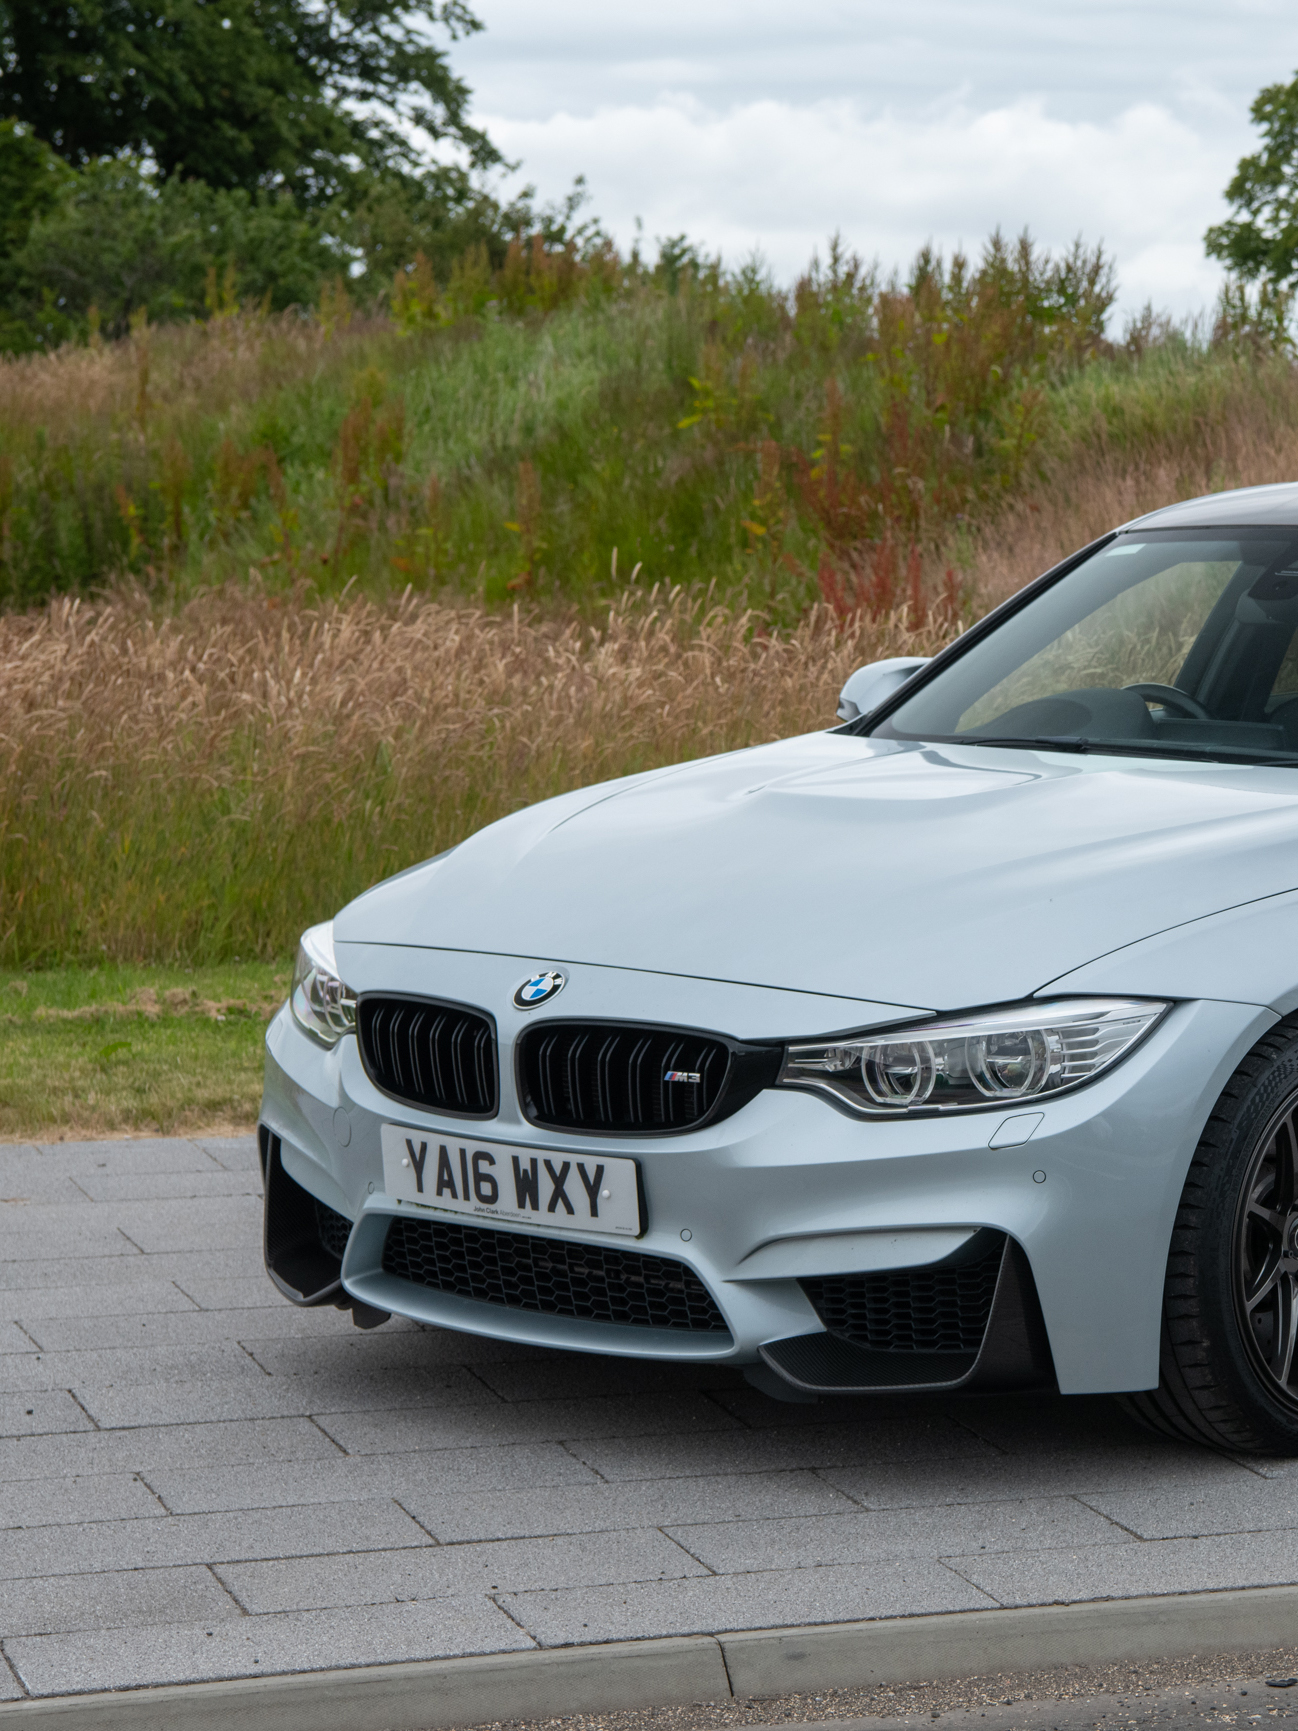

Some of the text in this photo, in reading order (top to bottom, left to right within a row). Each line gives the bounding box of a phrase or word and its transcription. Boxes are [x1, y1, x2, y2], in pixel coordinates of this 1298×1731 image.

[673, 1071, 701, 1083] M3
[405, 1138, 605, 1218] YA16 WXY
[473, 1205, 486, 1213] John
[486, 1207, 499, 1215] Clark
